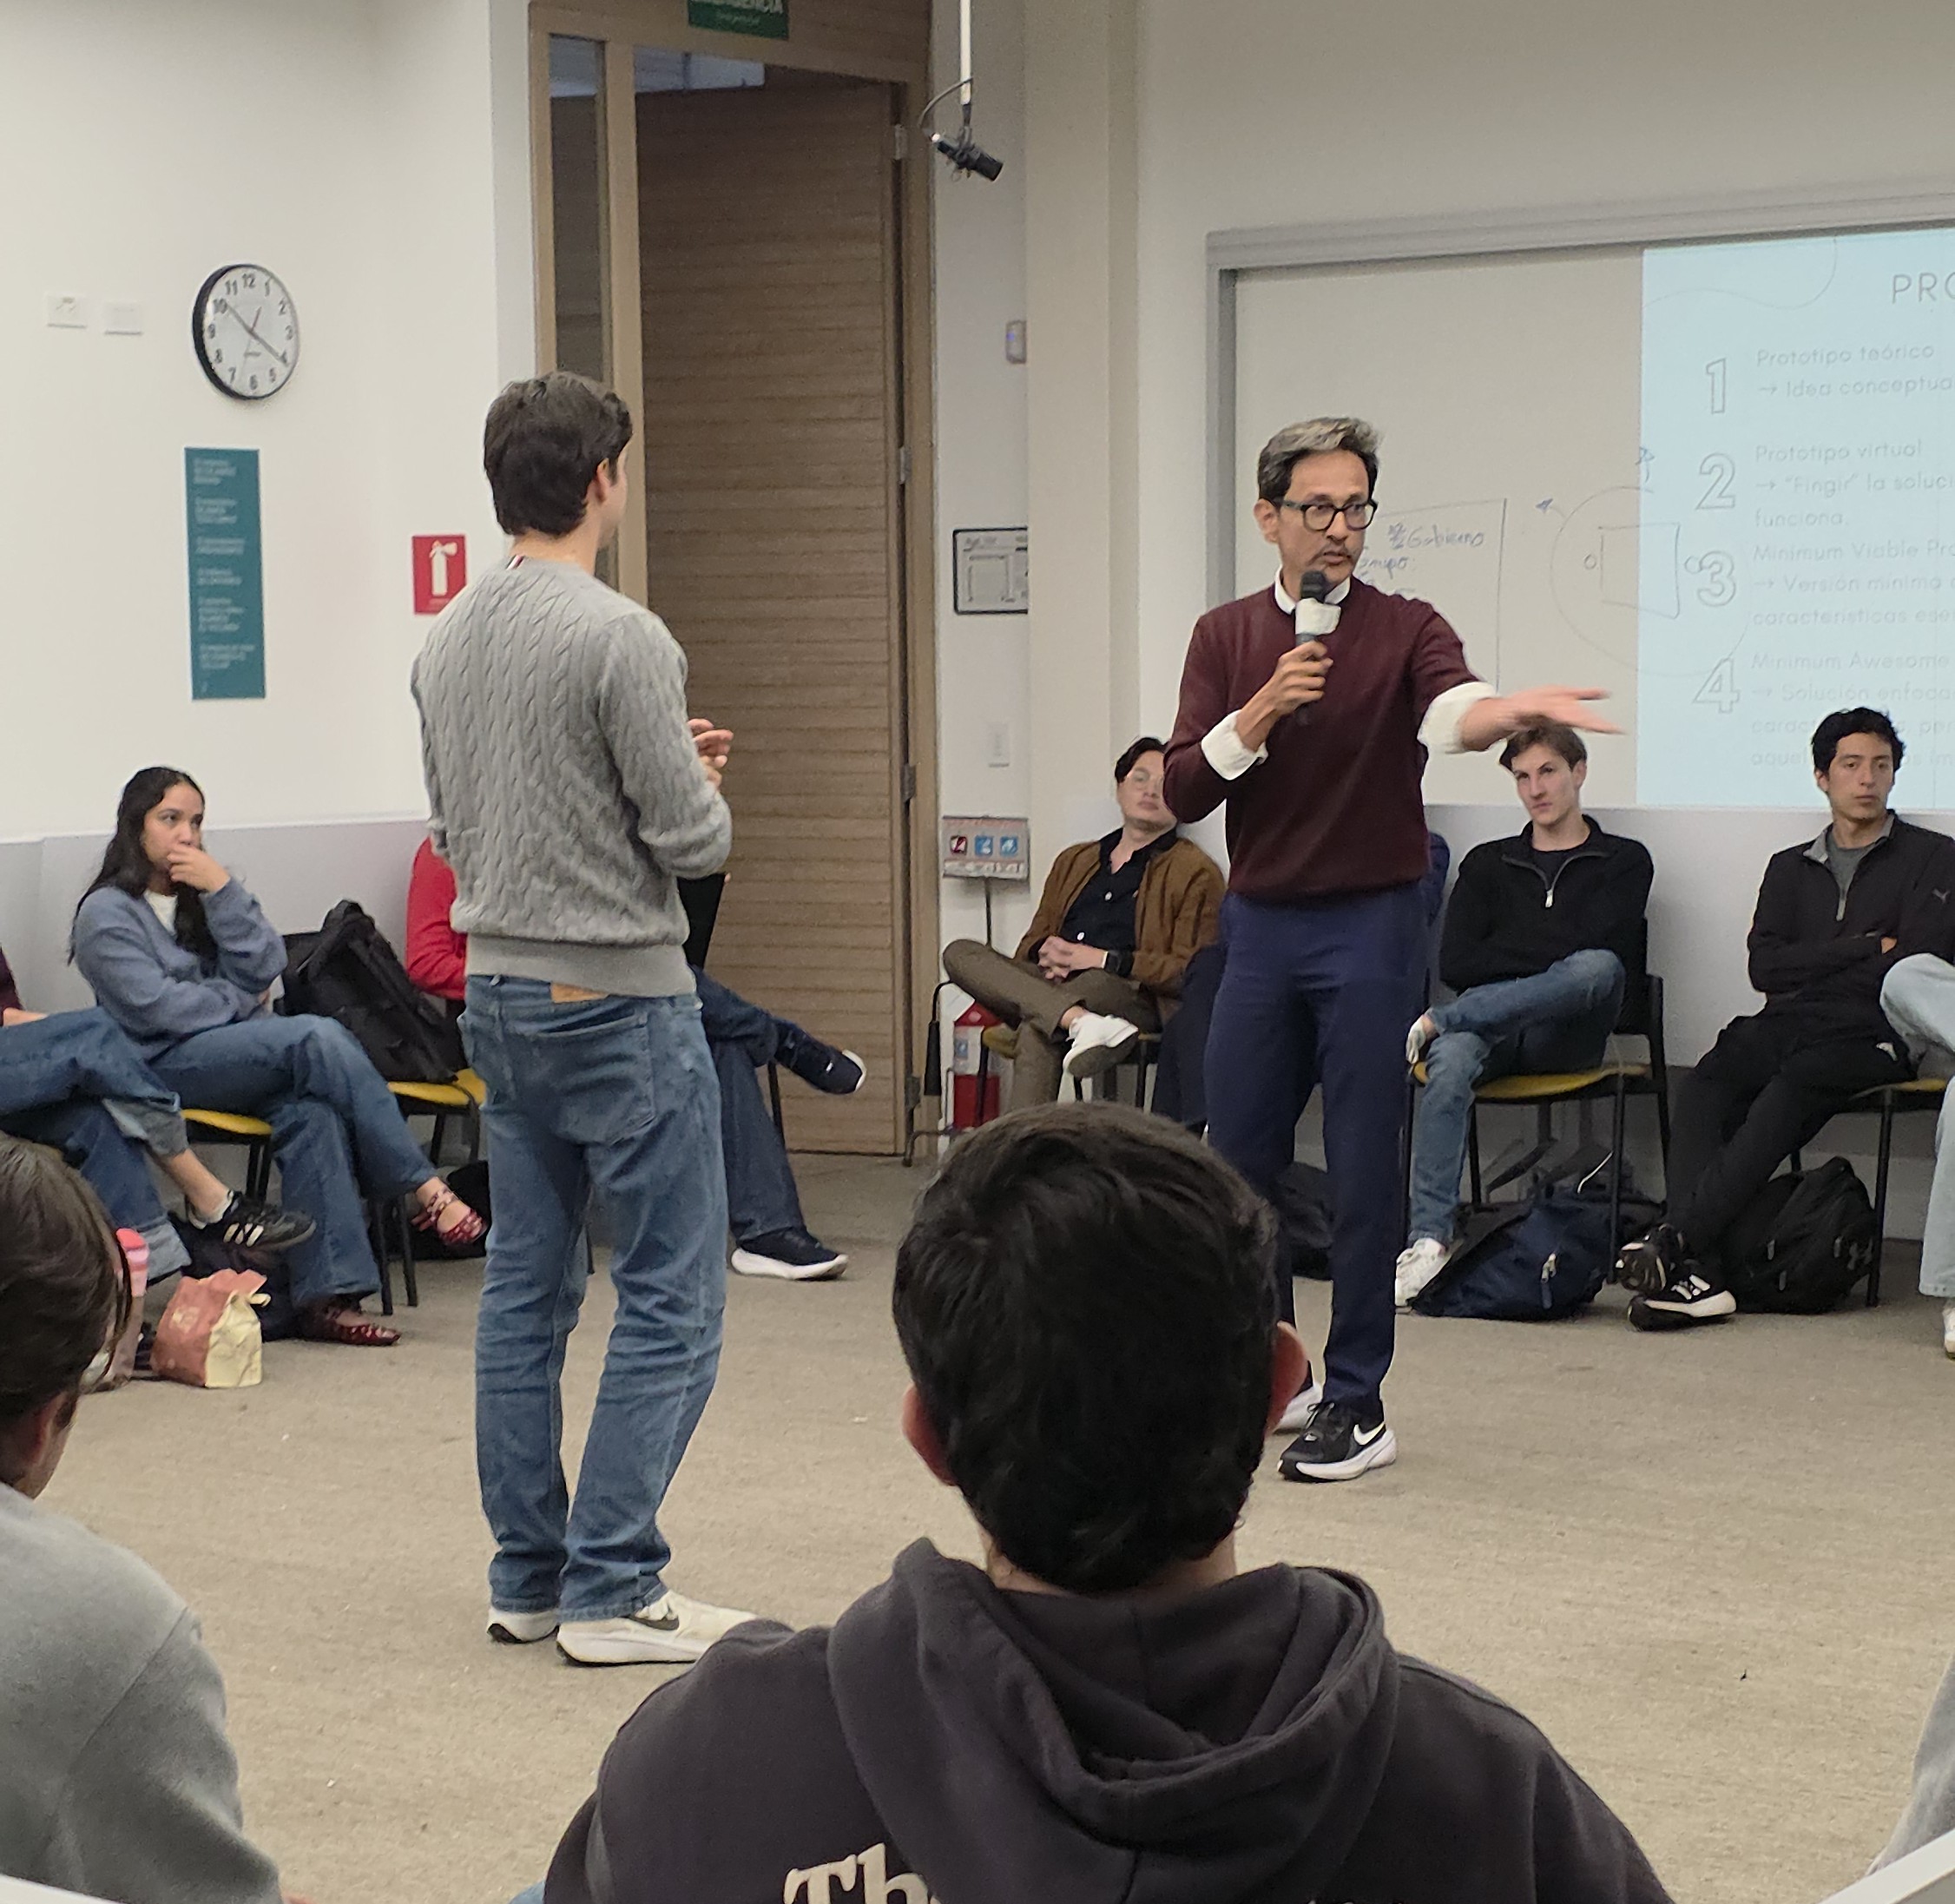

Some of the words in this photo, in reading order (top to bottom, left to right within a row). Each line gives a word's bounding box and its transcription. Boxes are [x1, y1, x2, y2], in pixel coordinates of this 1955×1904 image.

[225, 280, 238, 296] 11
[242, 273, 256, 288] 12
[264, 281, 271, 296] 1
[279, 300, 286, 315] 2
[285, 325, 293, 340] 3
[1756, 348, 1852, 367] Prototipo
[1860, 344, 1935, 360] teórico
[228, 367, 236, 383] 7
[249, 374, 259, 390] 6
[269, 367, 276, 383] 5
[1705, 358, 1727, 415] 1
[1786, 379, 1832, 398] Idea
[1754, 444, 1851, 464] Prototipo
[1857, 438, 1922, 458] virtual
[1695, 452, 1735, 511] 2
[1867, 472, 1886, 491] la
[1753, 543, 1843, 561] Minimum
[1851, 539, 1919, 559] Viable
[1696, 550, 1736, 607] 3
[1783, 572, 1860, 591] Versión
[1751, 652, 1841, 670] Minimum
[1849, 651, 1950, 669] Awesome
[1692, 656, 1741, 714] 4
[1781, 681, 1869, 702] Solución
[1878, 681, 1955, 702] enfoca
[783, 1841, 943, 1904] Th
